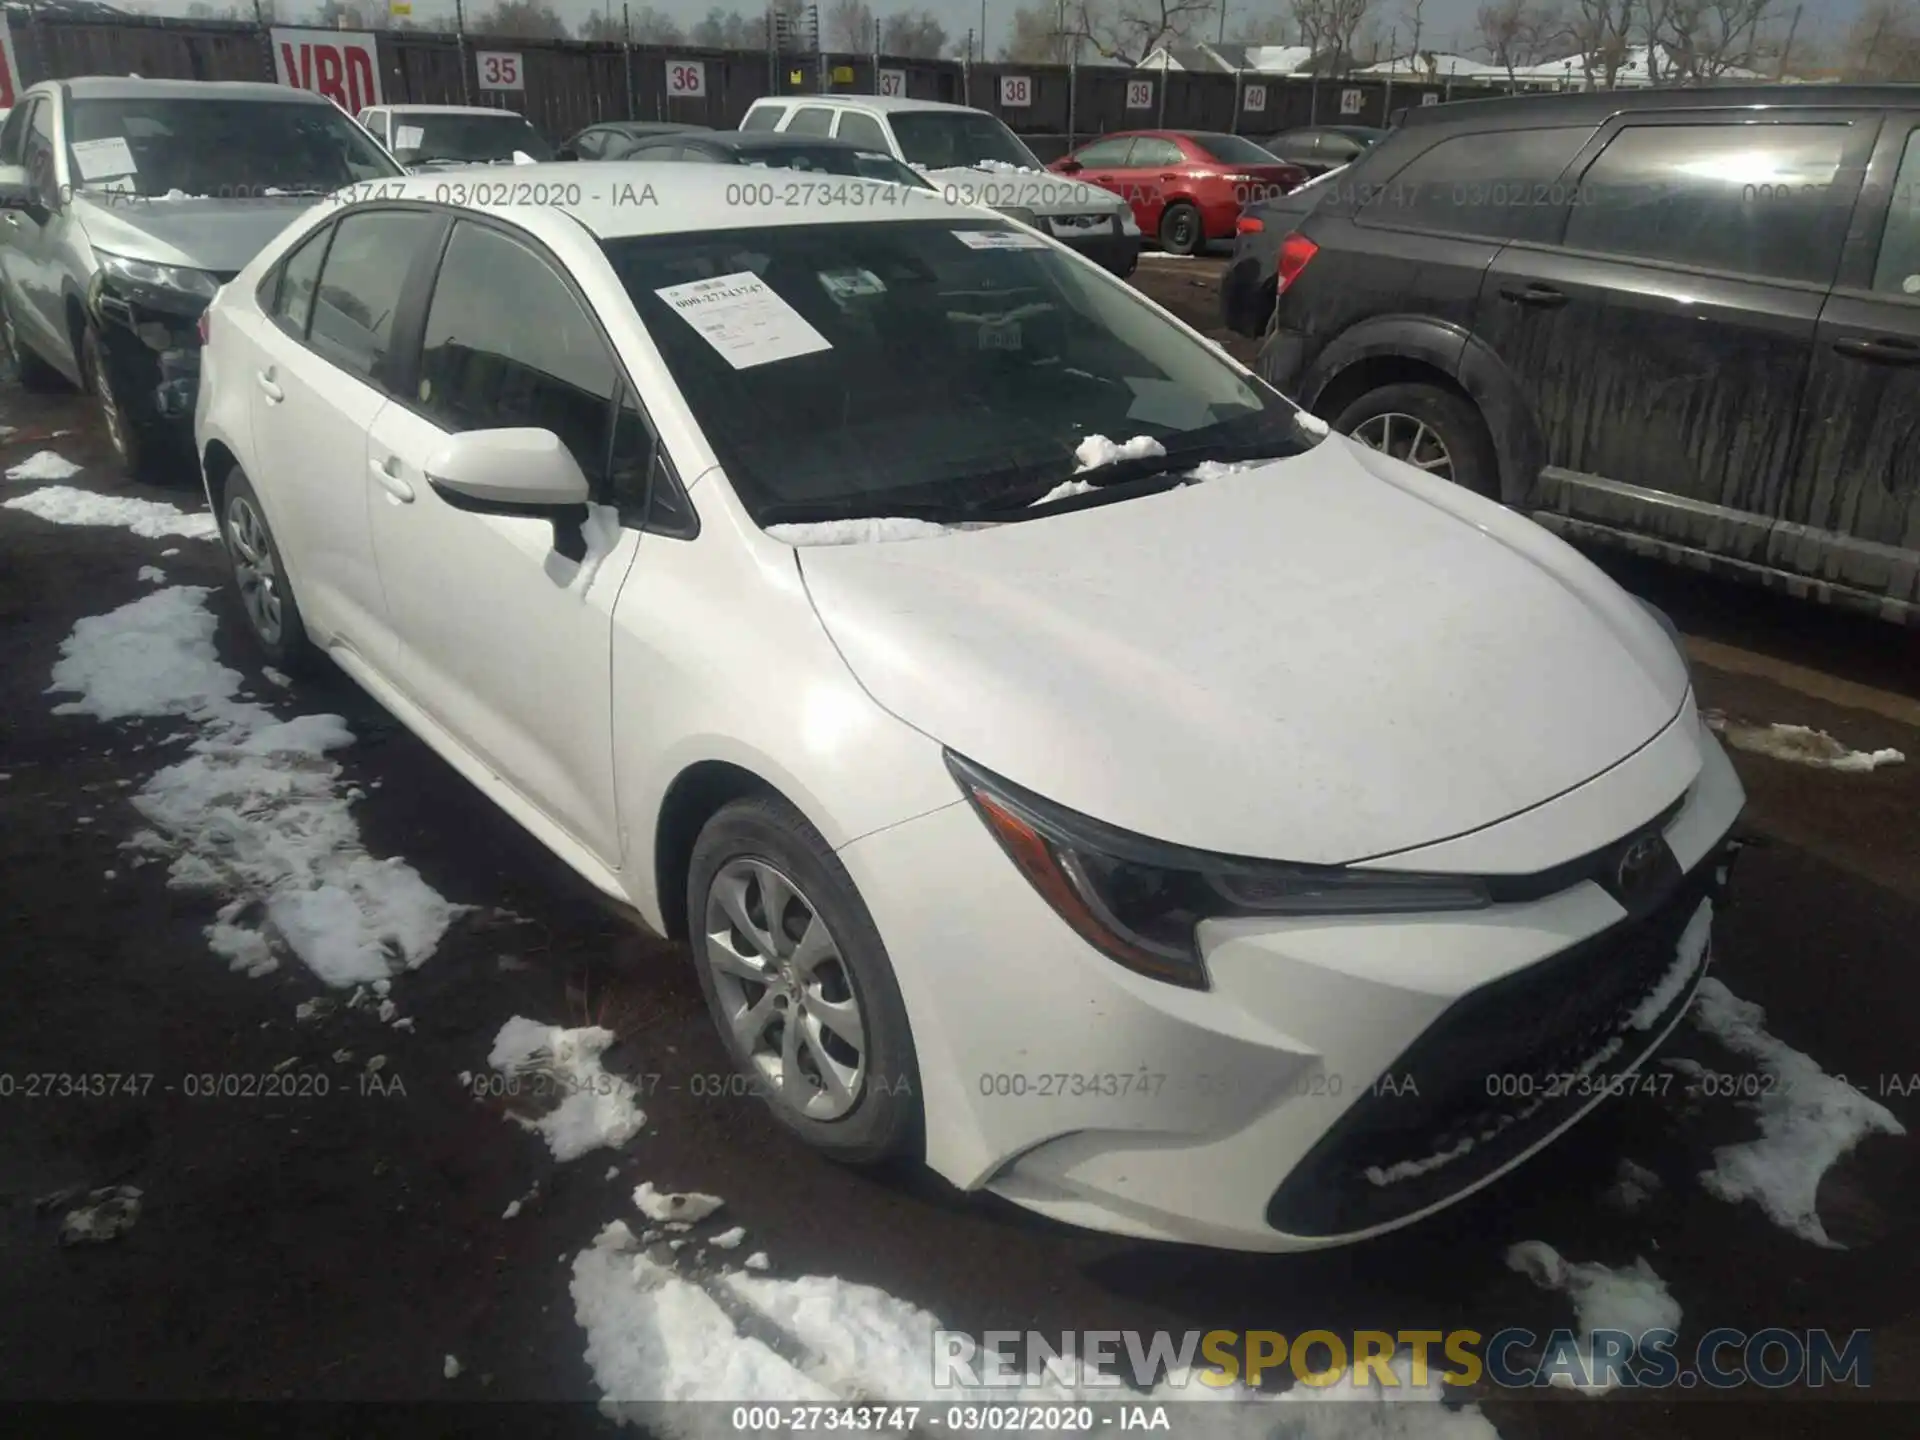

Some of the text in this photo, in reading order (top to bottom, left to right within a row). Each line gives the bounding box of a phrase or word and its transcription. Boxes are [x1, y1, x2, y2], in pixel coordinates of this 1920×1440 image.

[485, 57, 517, 84] 35
[672, 66, 699, 91] 36
[881, 74, 901, 96] 37
[1005, 80, 1027, 101] 38
[1131, 84, 1150, 105] 39
[1247, 90, 1263, 108] 40
